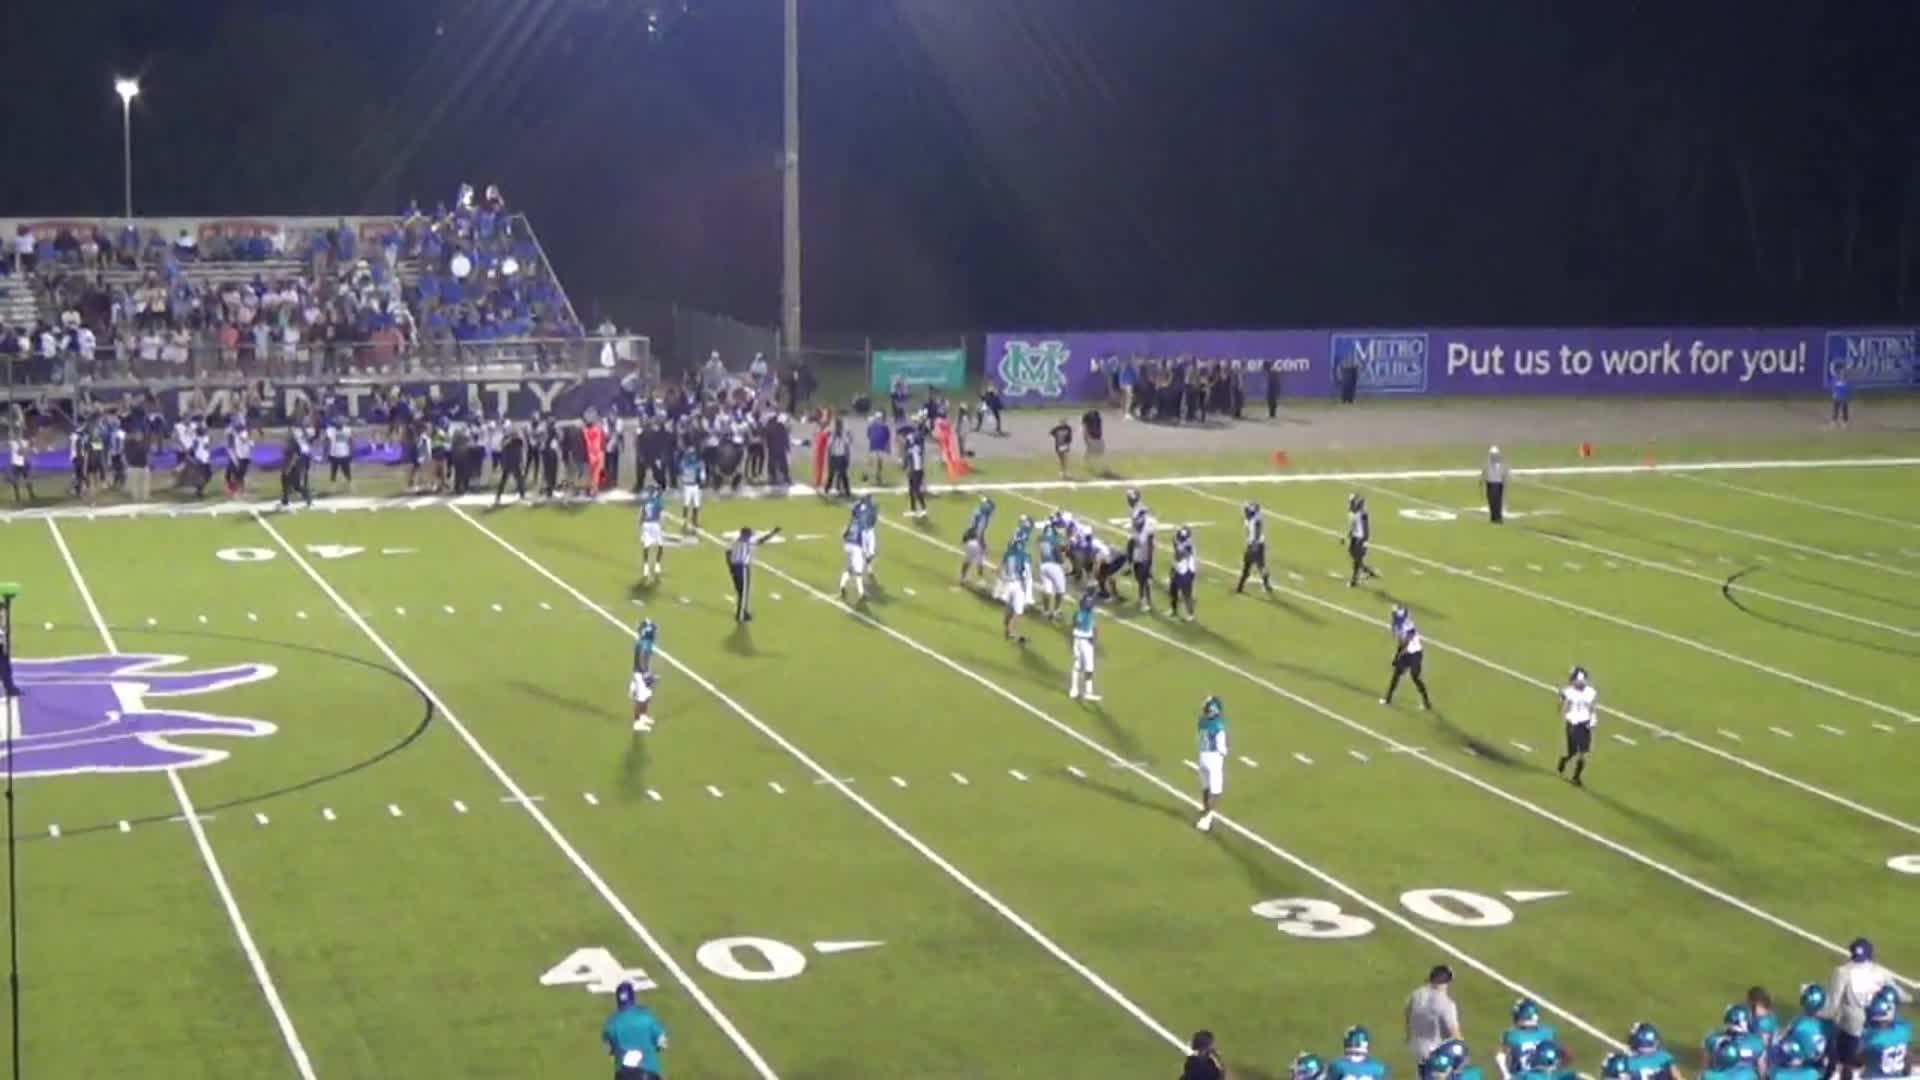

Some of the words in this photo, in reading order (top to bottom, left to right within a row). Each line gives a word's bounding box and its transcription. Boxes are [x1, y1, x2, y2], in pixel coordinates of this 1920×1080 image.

[1353, 338, 1424, 359] METRO
[1447, 343, 1504, 375] Put
[1514, 350, 1550, 374] us
[1560, 345, 1592, 374] to
[1602, 341, 1680, 374] work
[1690, 341, 1733, 374] for
[1740, 341, 1806, 381] you!
[177, 383, 567, 419] MNTITY
[1251, 888, 1514, 938] 30
[539, 937, 807, 993] 40
